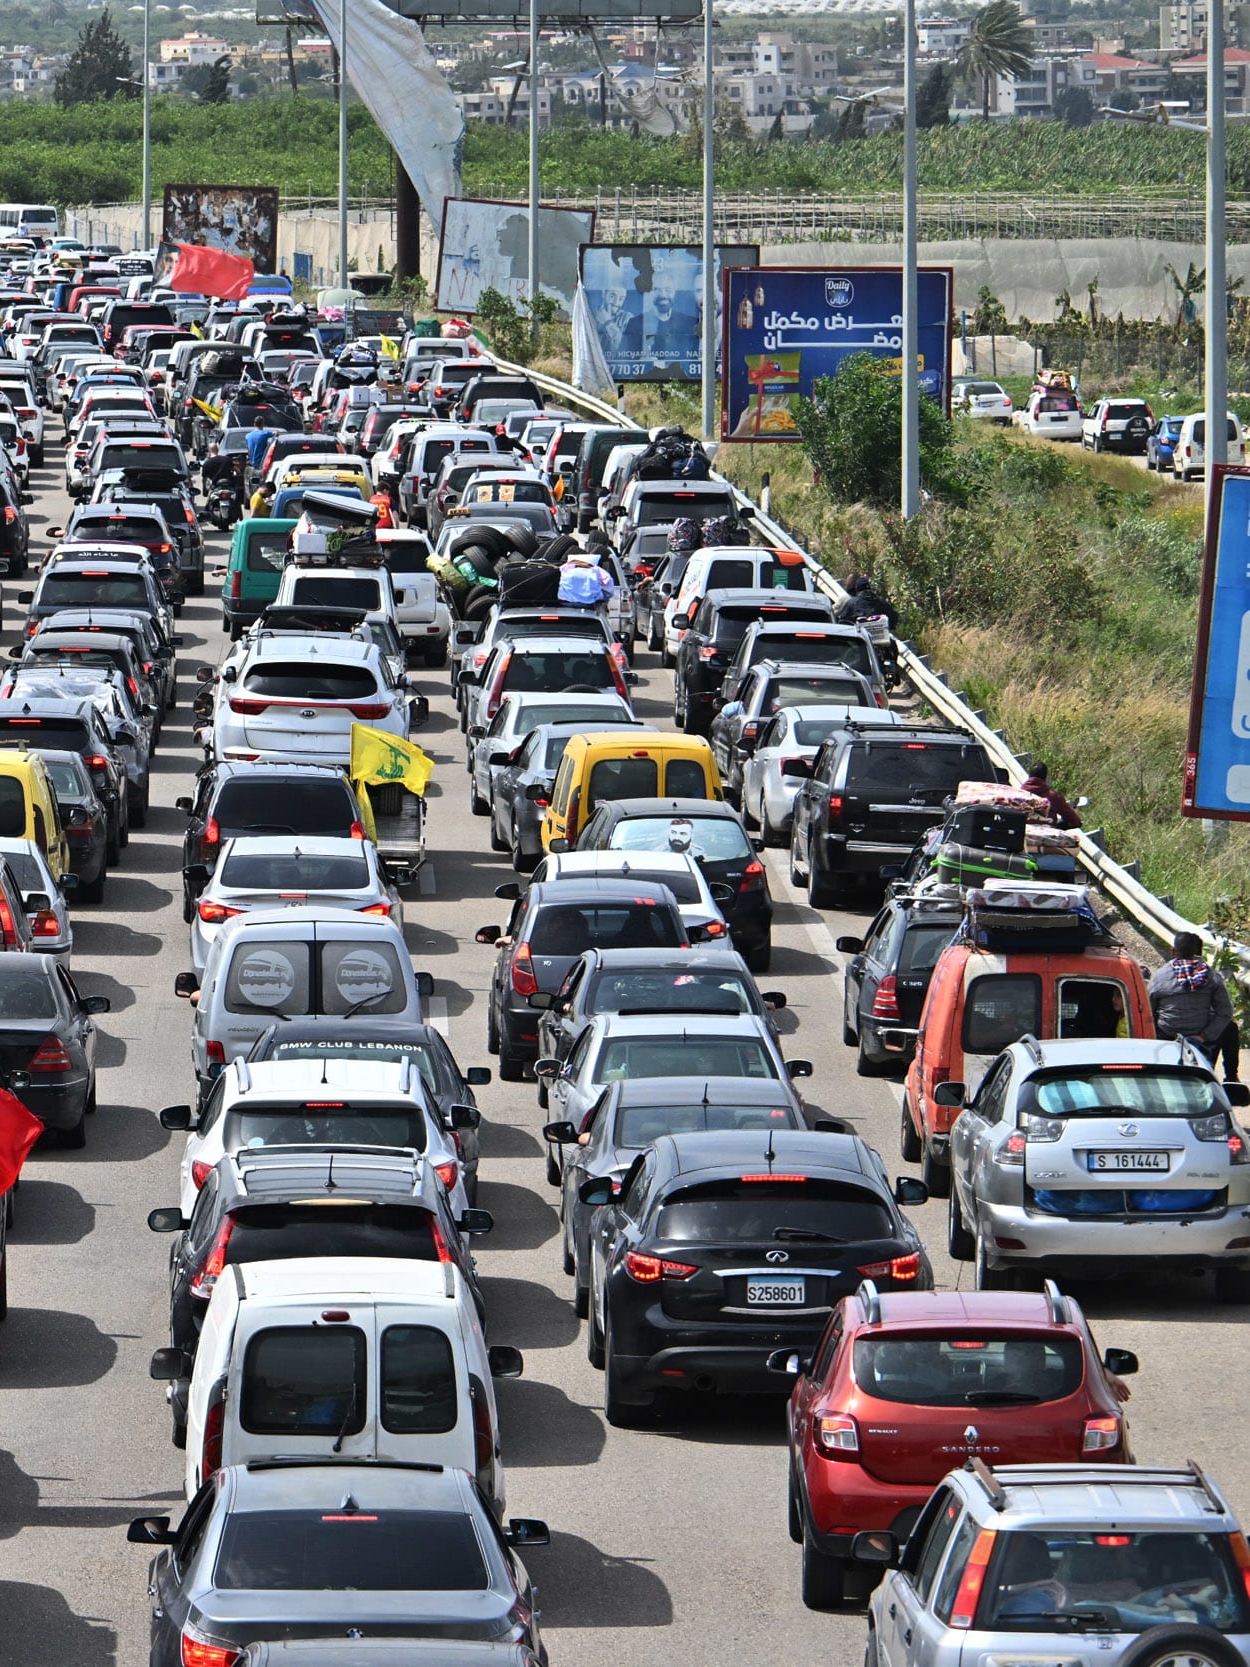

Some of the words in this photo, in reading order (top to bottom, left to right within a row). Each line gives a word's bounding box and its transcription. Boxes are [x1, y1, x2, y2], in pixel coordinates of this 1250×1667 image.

[828, 280, 850, 292] Daily
[632, 364, 646, 374] 37
[1186, 758, 1196, 776] 365
[359, 1042, 422, 1052] LEBANON
[1098, 1155, 1106, 1168] S
[1116, 1155, 1160, 1168] 161444
[748, 1286, 803, 1302] S258601
